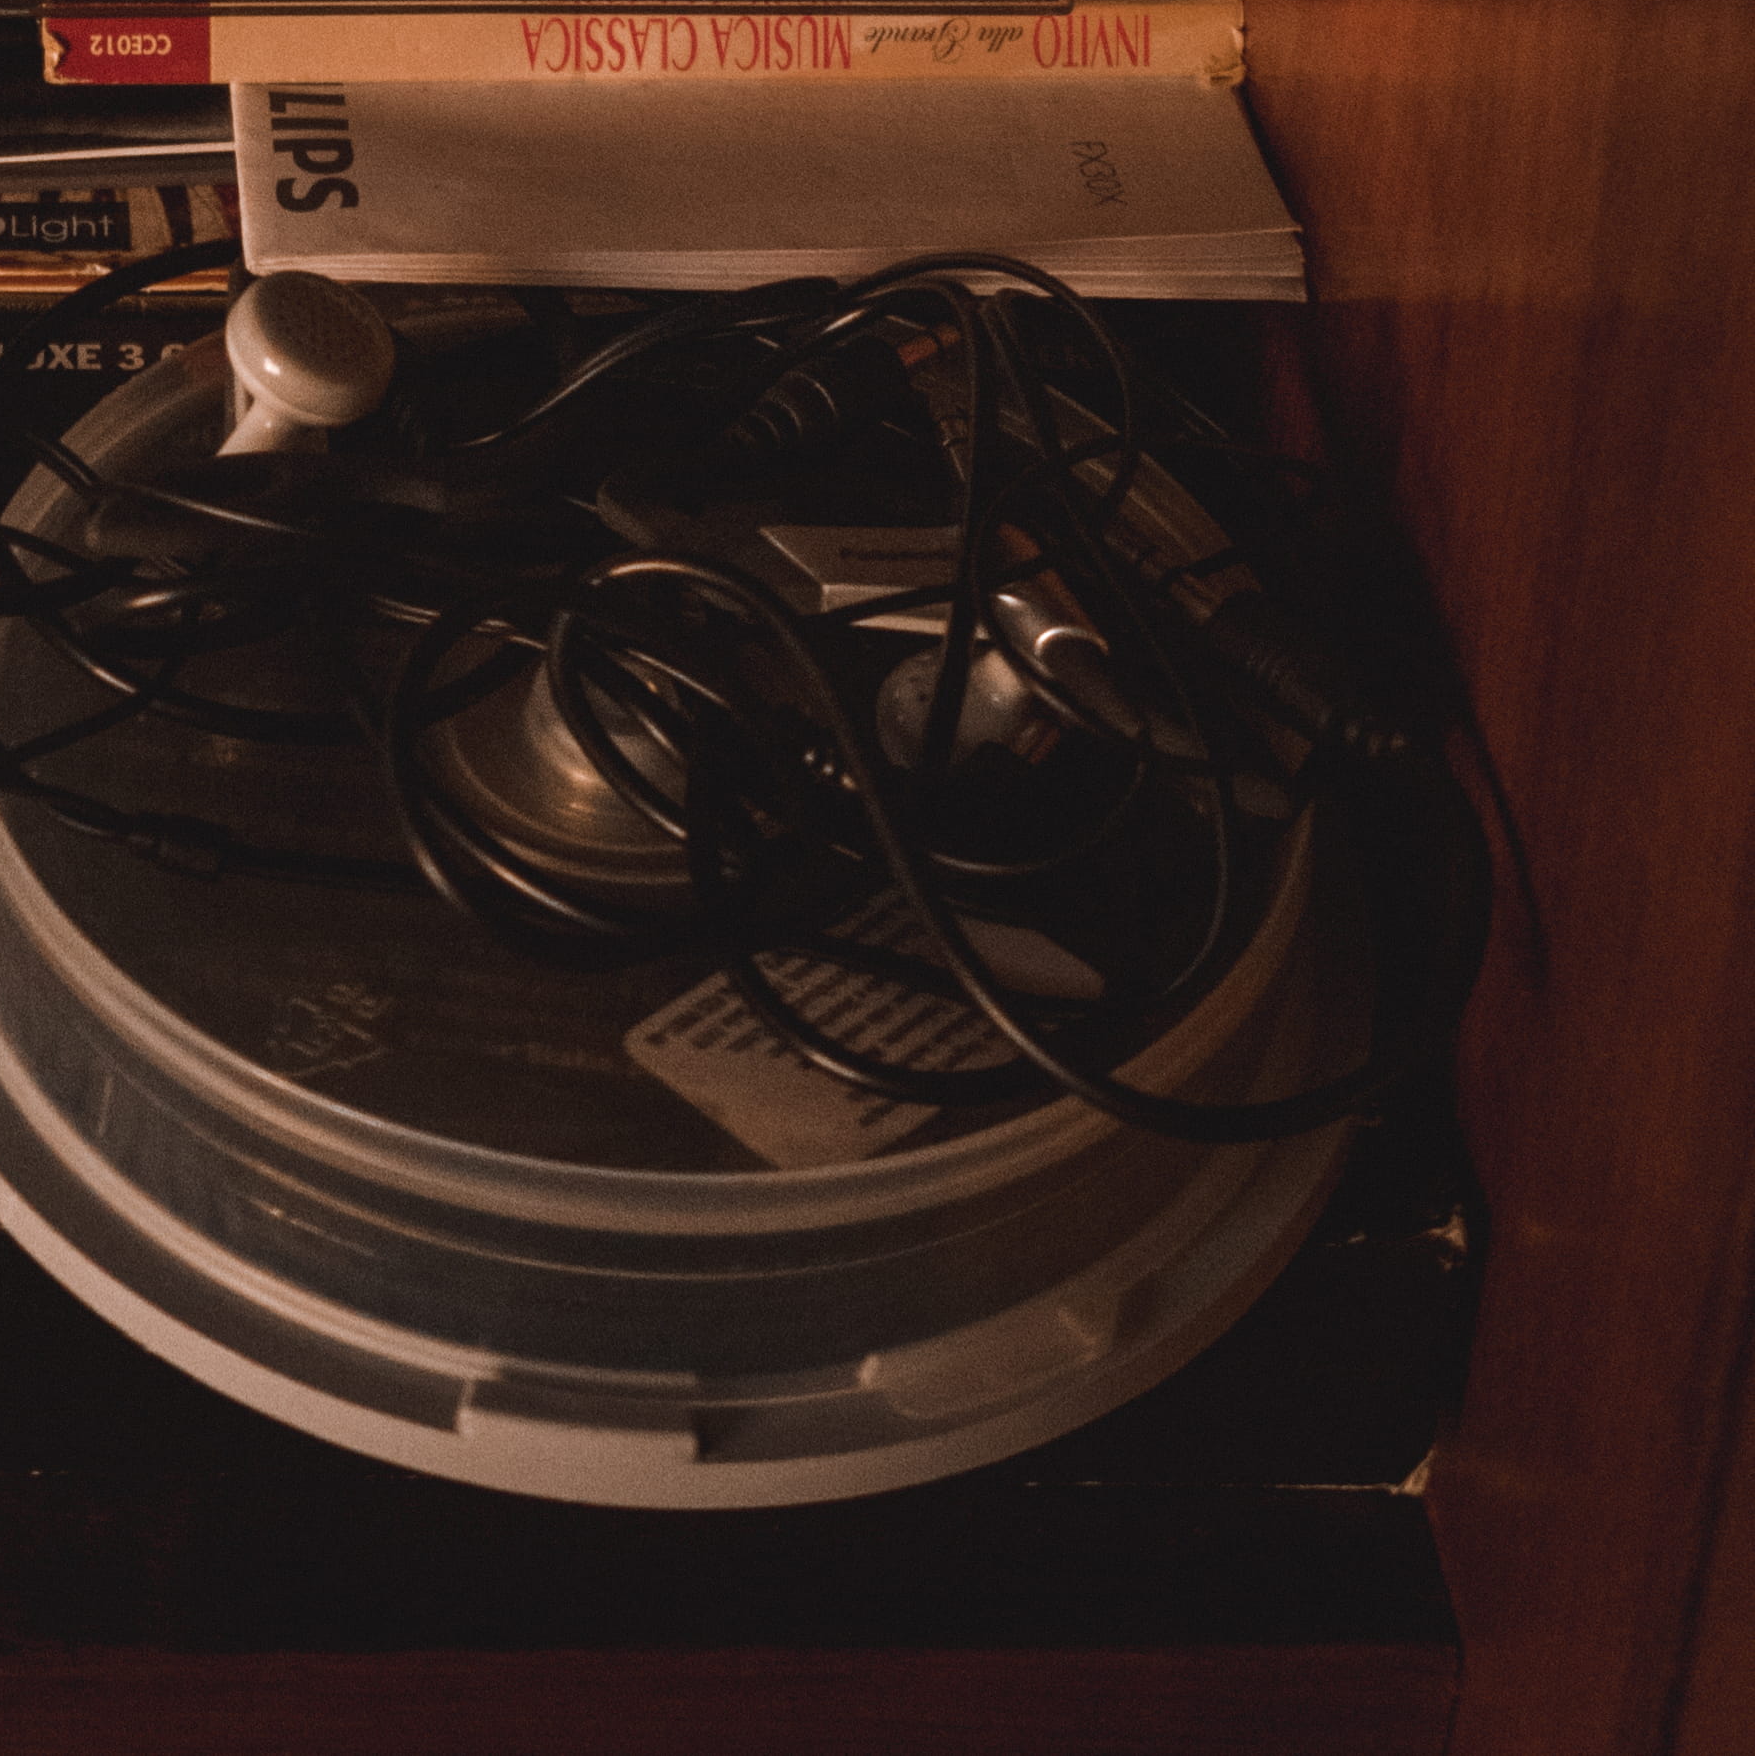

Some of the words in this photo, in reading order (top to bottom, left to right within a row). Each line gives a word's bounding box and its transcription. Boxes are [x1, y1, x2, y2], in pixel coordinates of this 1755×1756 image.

[520, 19, 699, 73] CLASSICA
[710, 17, 853, 71] MUSICA
[862, 20, 972, 62] Grande
[976, 26, 1025, 55] alla
[1031, 16, 1152, 69] INVITO
[269, 84, 360, 213] LIPS
[118, 342, 146, 369] 3
